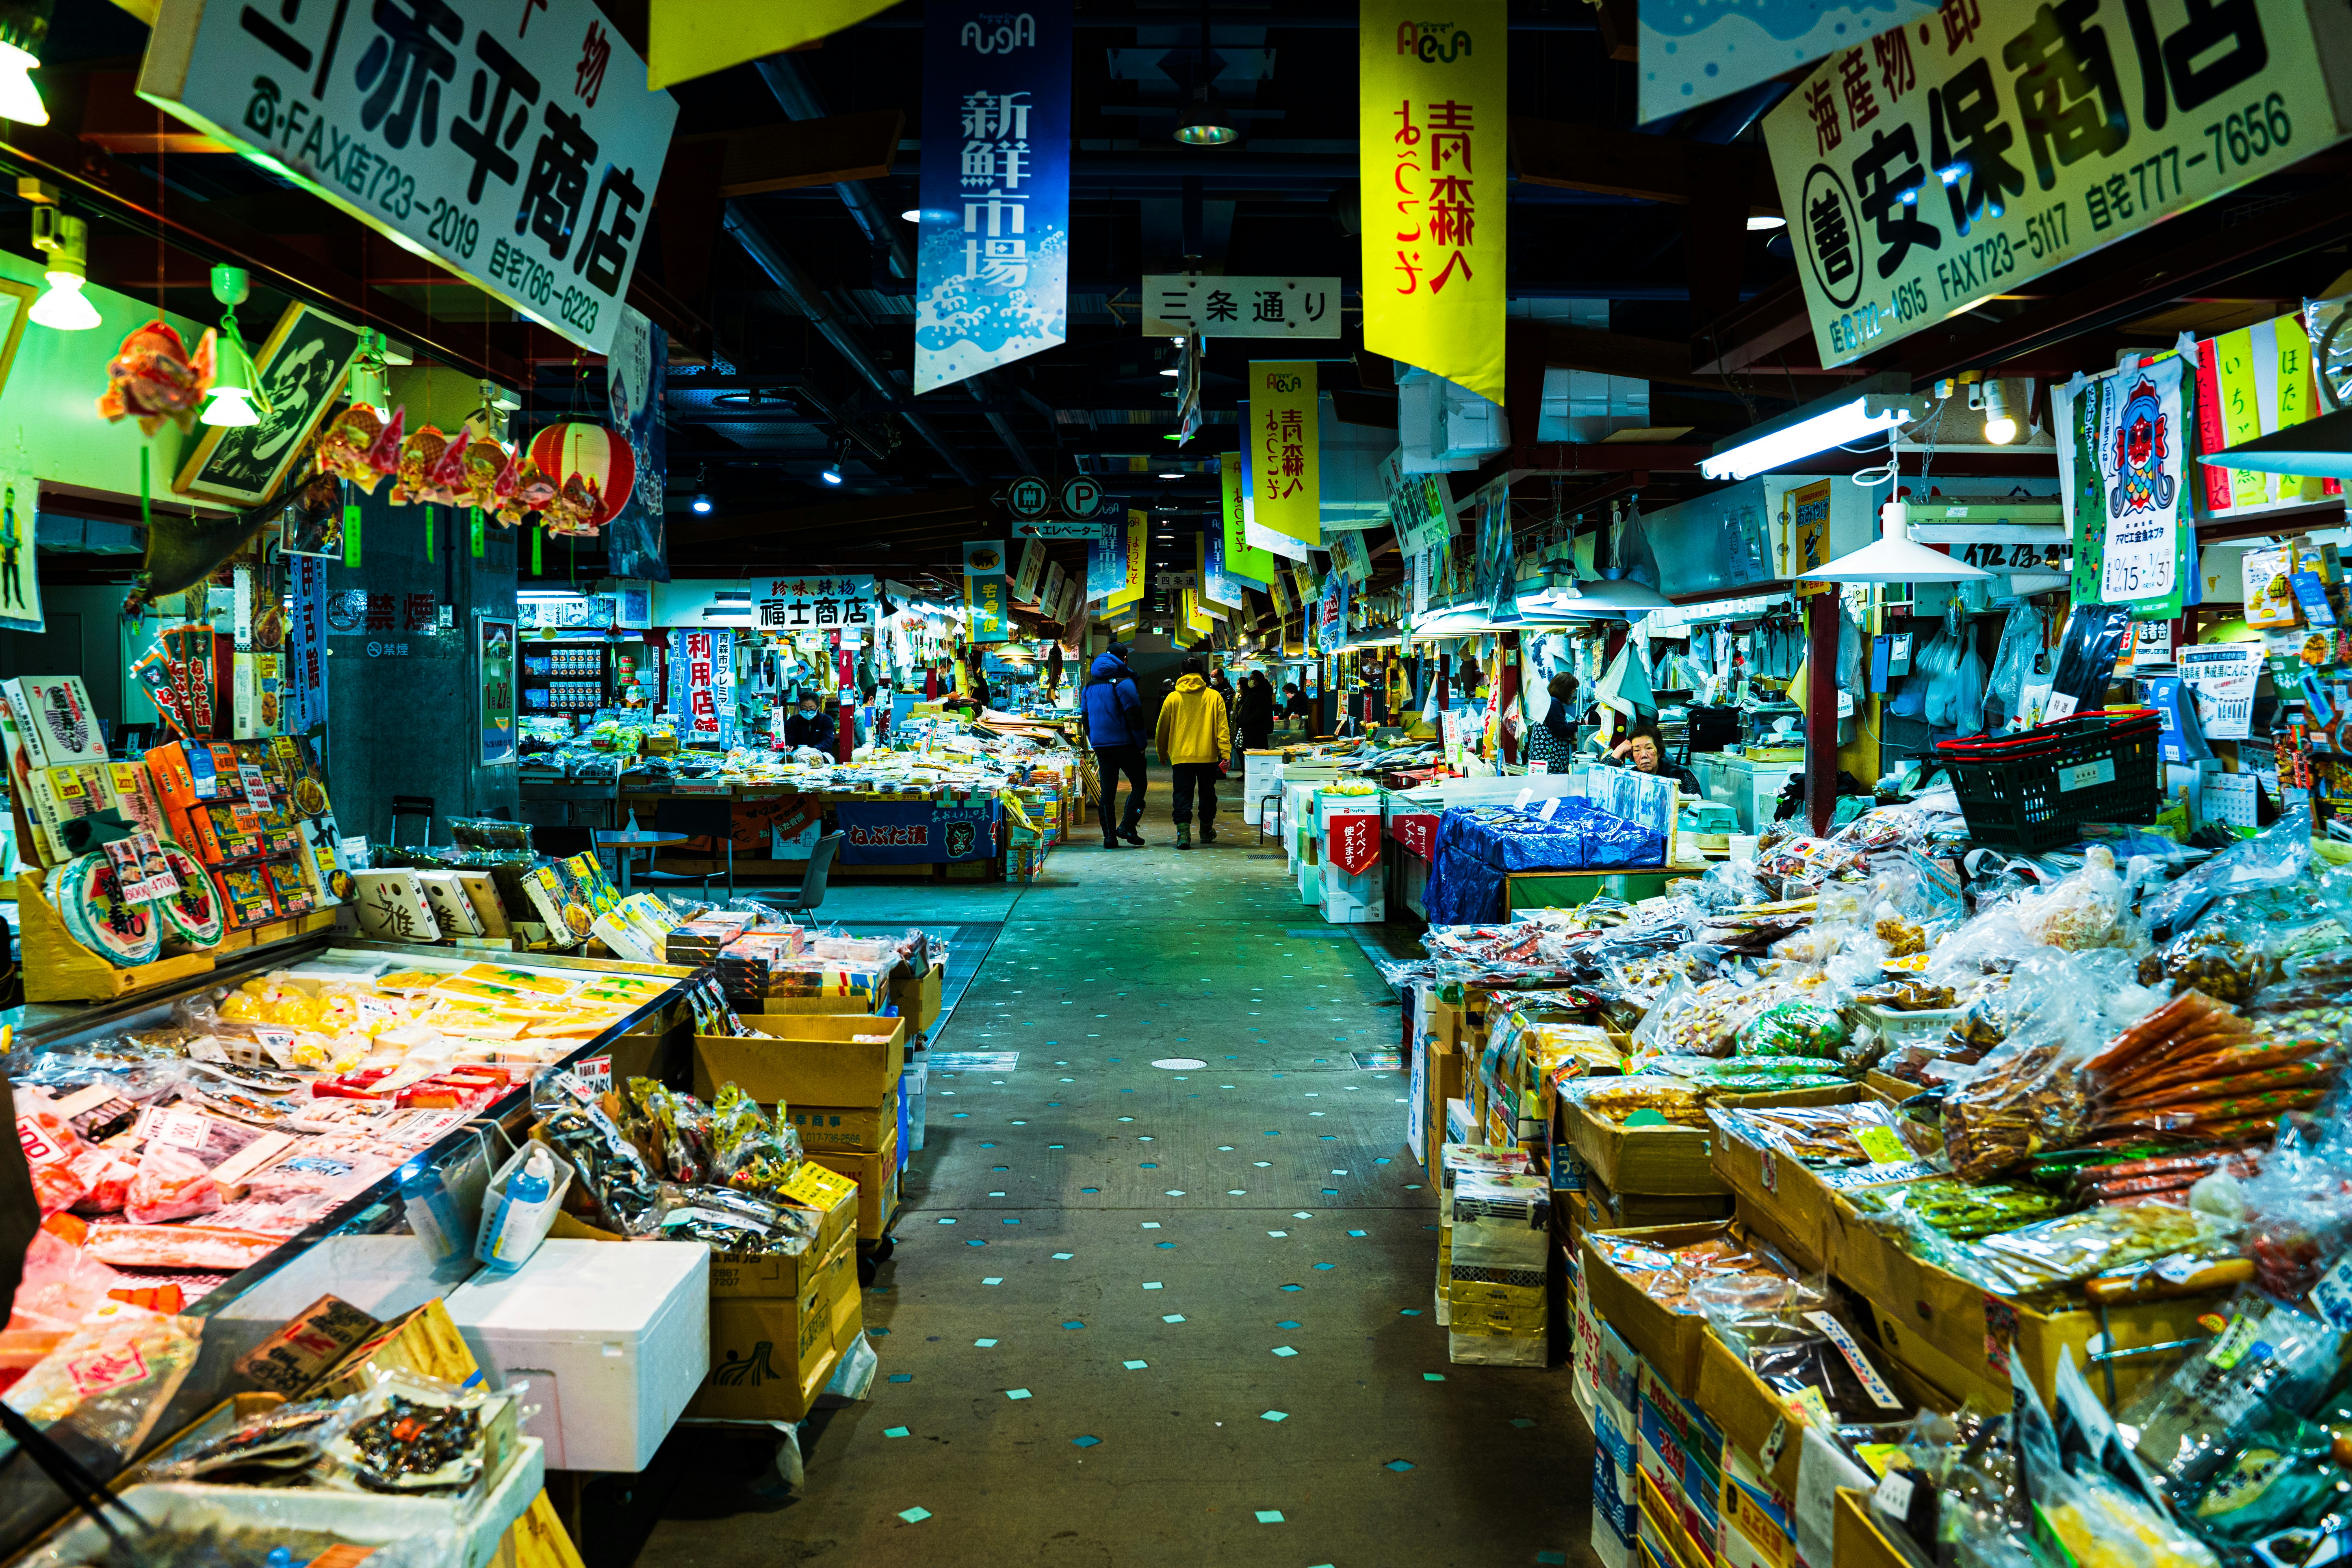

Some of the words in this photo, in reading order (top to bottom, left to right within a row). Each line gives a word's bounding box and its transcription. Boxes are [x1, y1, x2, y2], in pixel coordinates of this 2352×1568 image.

[356, 0, 645, 297] 赤平商店
[1853, 0, 2268, 280] 安保商店
[2085, 91, 2293, 233] 自宅777-7656
[960, 91, 1031, 287] 新鮮市場
[486, 238, 600, 335] 自宅766-6223
[1159, 290, 1327, 324] 三条通り
[1043, 525, 1101, 536] エレベーター
[1796, 496, 1830, 527] おみやげ
[1099, 523, 1118, 575] 新鮮市場
[1130, 536, 1140, 585] ようこそ
[2272, 575, 2285, 590] 新
[366, 593, 434, 632] 禁煙
[760, 596, 869, 626] 福士商店
[982, 583, 999, 633] 宅急便
[384, 643, 408, 656] 禁煙
[687, 633, 718, 732] 利用店舗
[2203, 664, 2254, 679] 熟成黒にんにく
[190, 657, 212, 728] ねぶた漬
[849, 825, 928, 846] ねぶた漬
[932, 809, 990, 823] あおもりの味
[1344, 826, 1355, 868] 使えます。
[1356, 819, 1366, 857] ペイペイ
[124, 885, 151, 901] 6000
[151, 876, 176, 891] 4700
[1578, 1308, 1600, 1359] ほたて
